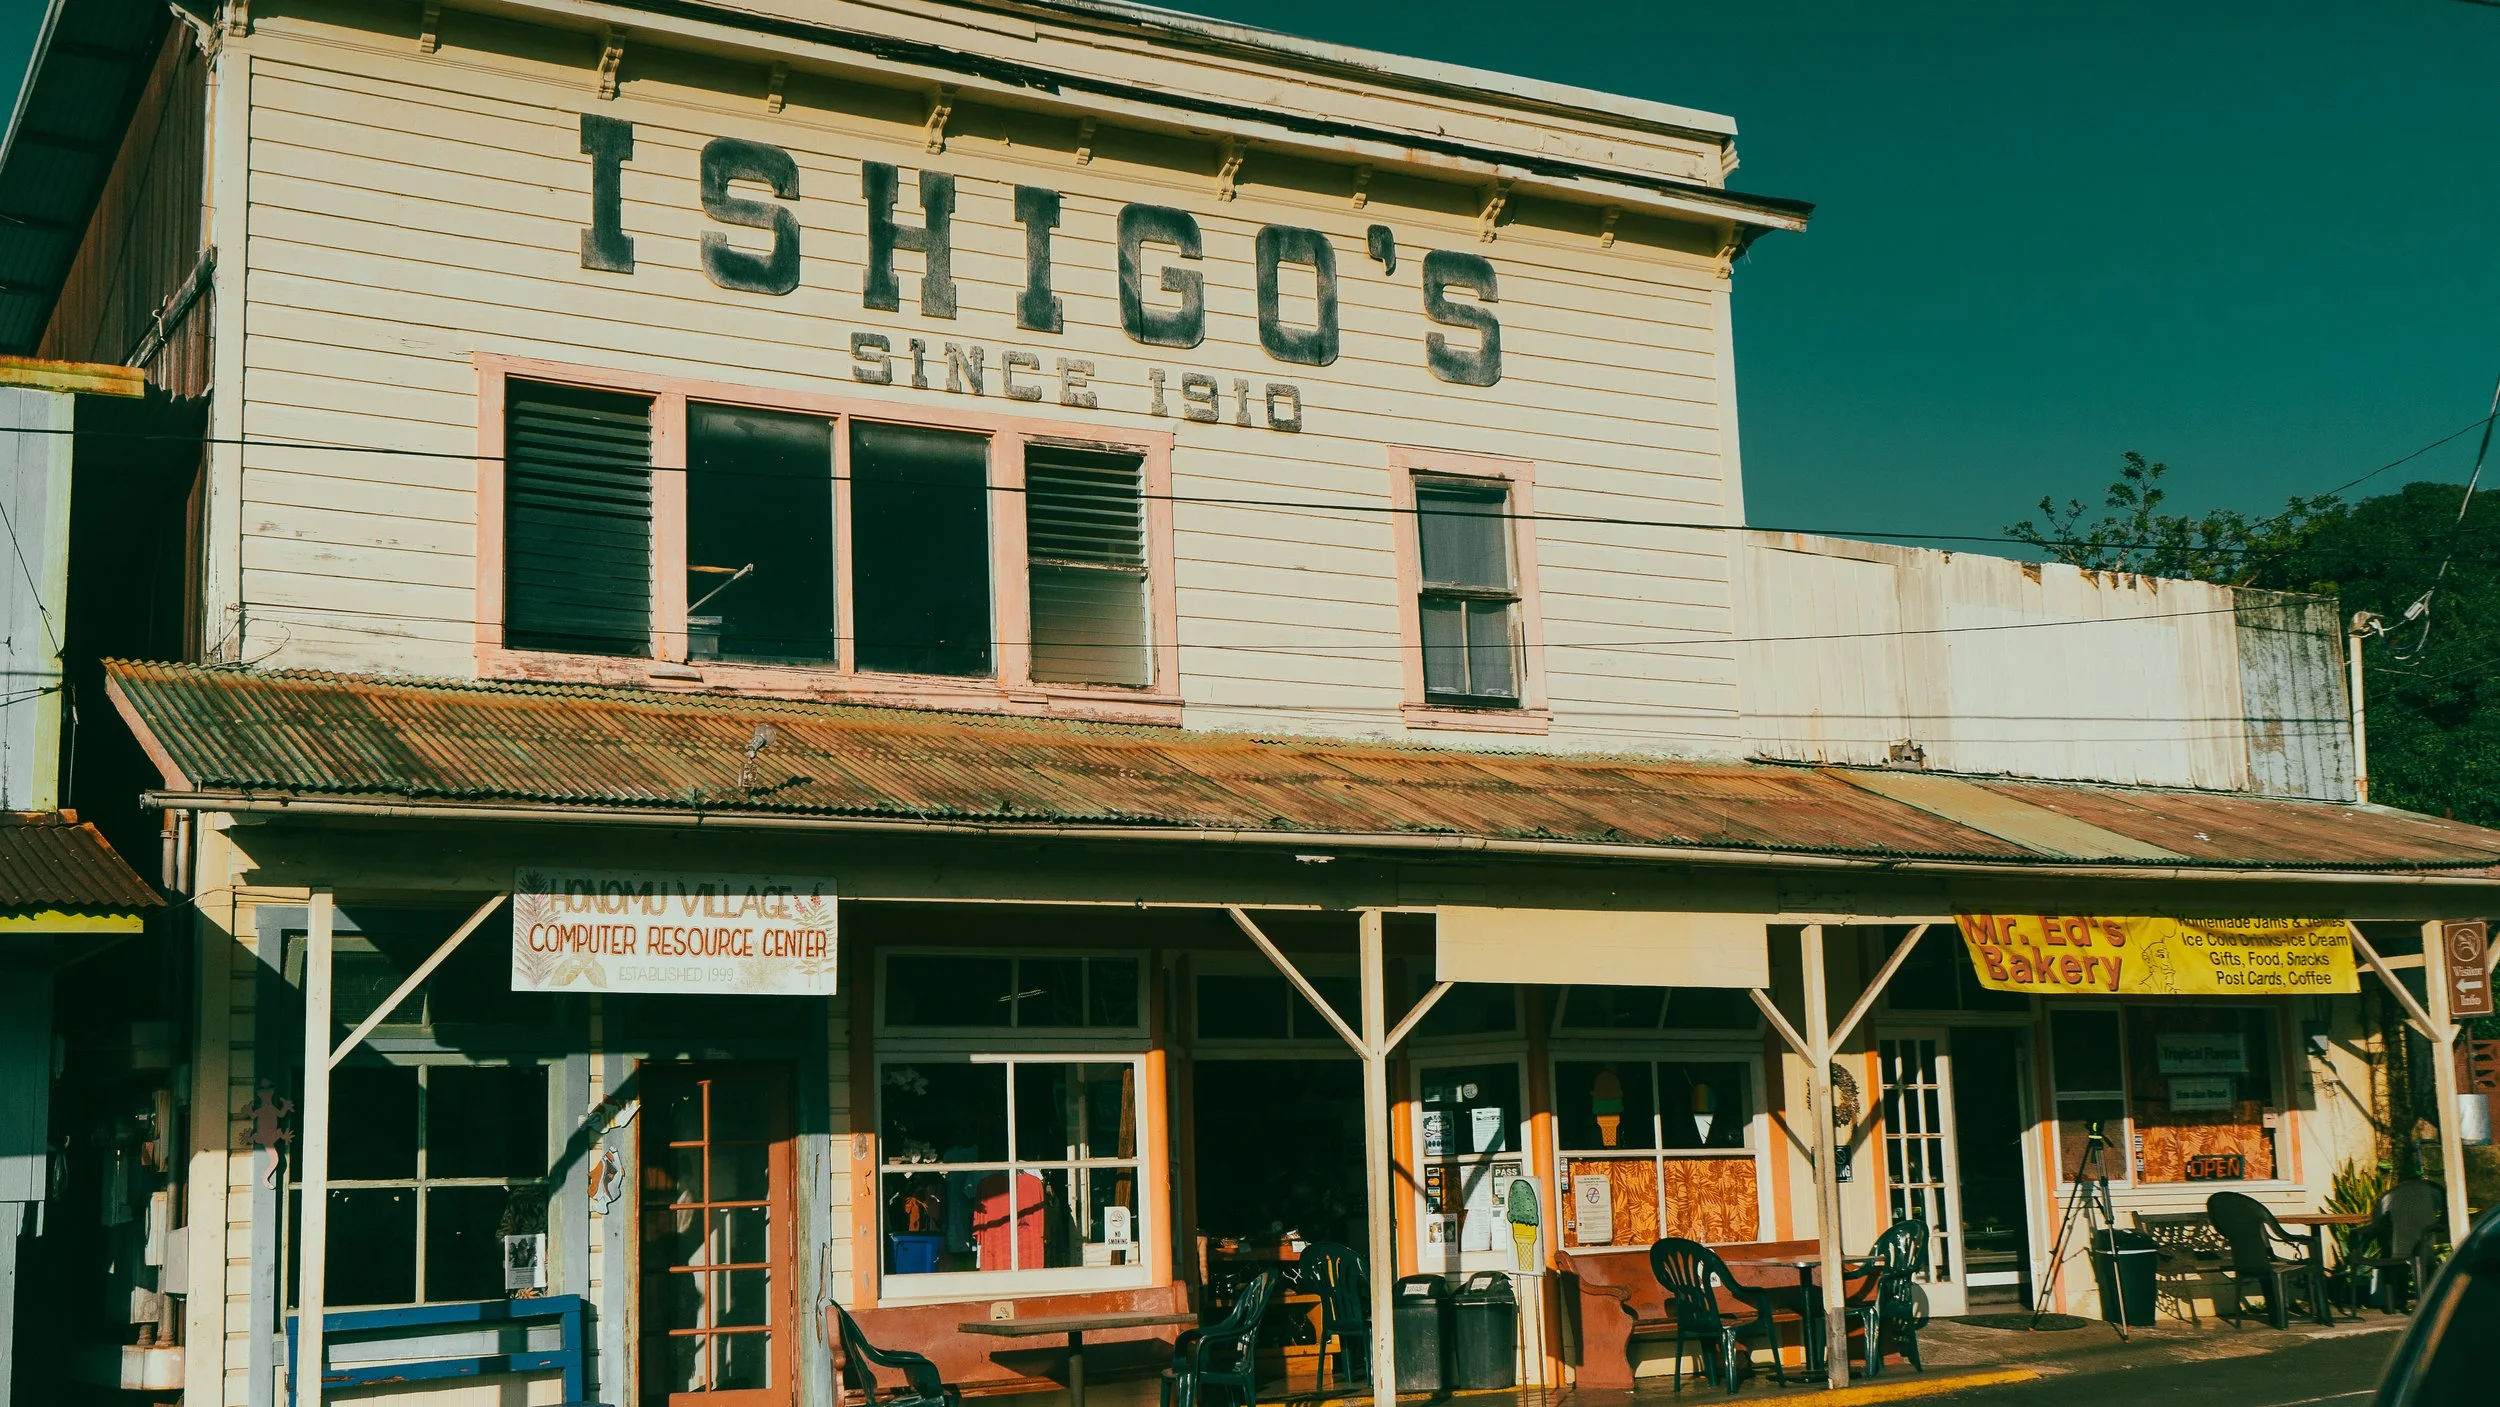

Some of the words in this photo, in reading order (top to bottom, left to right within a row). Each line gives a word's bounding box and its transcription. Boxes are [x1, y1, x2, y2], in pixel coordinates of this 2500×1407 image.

[580, 114, 1503, 387] ISHIGO'S
[850, 331, 1098, 408] SINCE
[1148, 368, 1302, 432] 1910
[549, 877, 668, 916] HONOMU
[677, 880, 793, 919] VILLAGE
[1961, 910, 2029, 945] Mr.
[2038, 911, 2126, 947] Ed's
[2254, 914, 2288, 929] Jams
[528, 923, 636, 955] COMPUTER
[646, 925, 754, 957] RESOURCE
[762, 928, 828, 958] CENTER
[2182, 932, 2203, 946] Ice
[2207, 932, 2237, 946] Cold
[2309, 932, 2348, 946] Cream
[1980, 946, 2122, 991] Bakery
[2210, 952, 2246, 968] Gifts,
[2248, 952, 2284, 968] Food,
[2287, 952, 2330, 966] Snacks
[618, 965, 703, 982] ESTABLISHED
[708, 967, 734, 983] 1999
[2217, 971, 2245, 985] Post
[2289, 971, 2332, 985] Coffee
[2452, 966, 2483, 976] Visitor
[1495, 1168, 1517, 1176] PASS
[2190, 1157, 2241, 1178] OPEN
